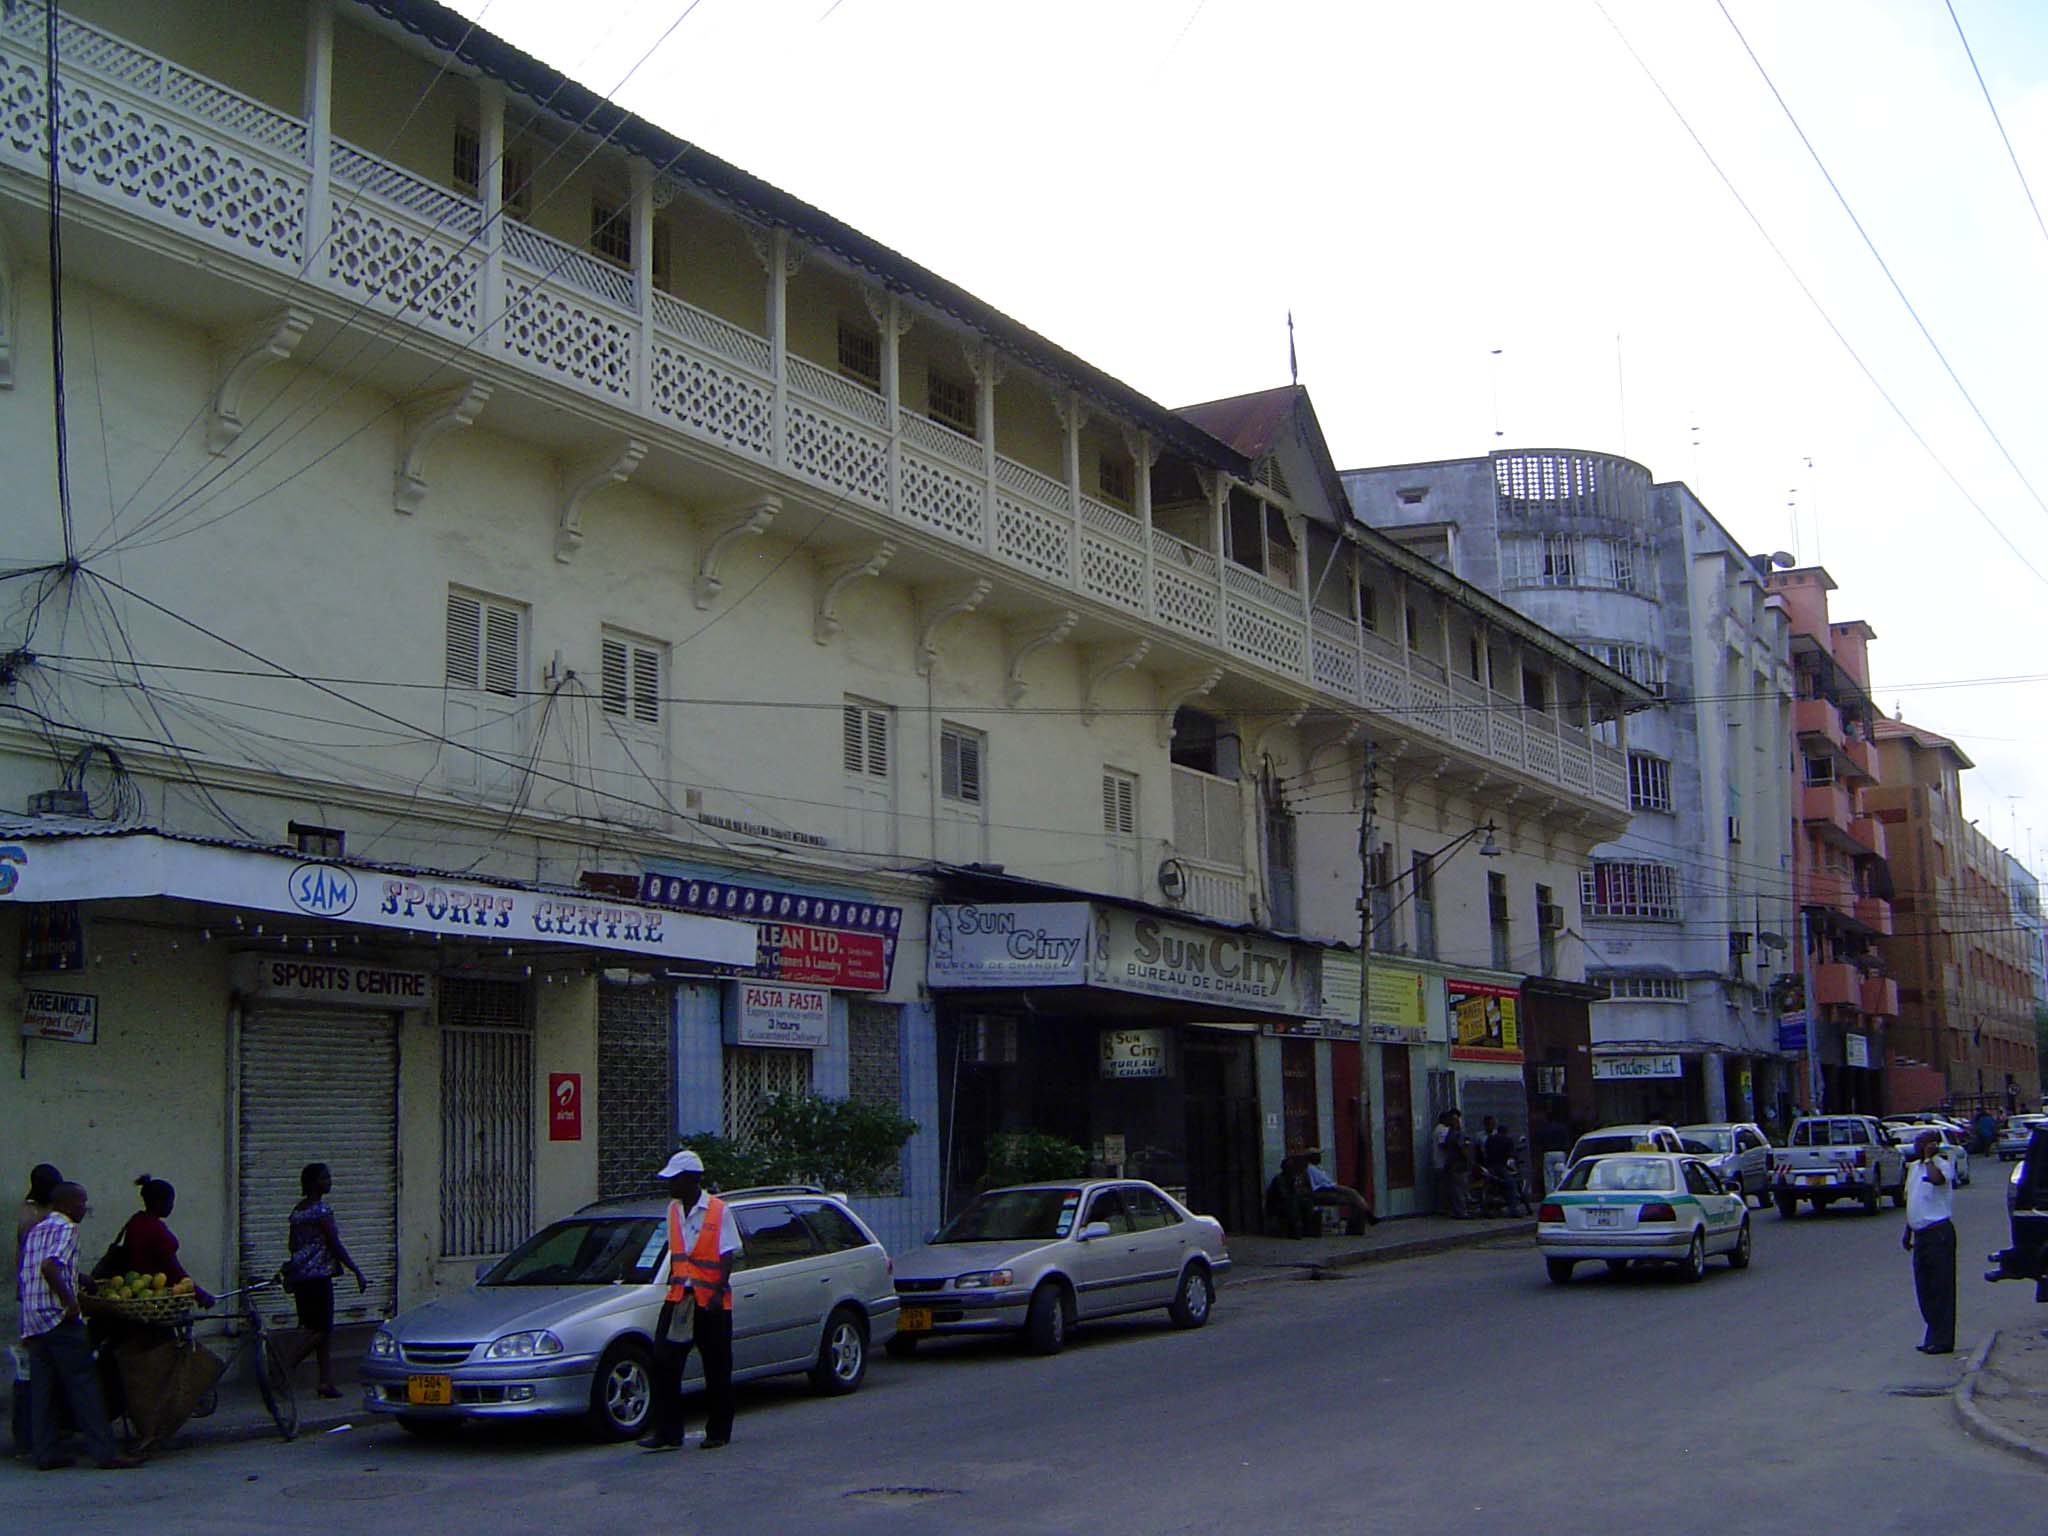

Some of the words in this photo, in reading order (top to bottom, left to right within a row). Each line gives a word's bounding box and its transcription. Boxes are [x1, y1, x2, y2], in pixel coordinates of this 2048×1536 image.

[299, 866, 347, 910] SAM
[381, 880, 513, 928] SPORTS
[532, 900, 663, 943] CENTRE
[957, 903, 1014, 935] SUN
[757, 924, 803, 950] LEAN
[810, 930, 845, 954] LTD.
[1134, 919, 1205, 973] SUN
[272, 963, 349, 991] SPORTS
[356, 969, 425, 996] CENTRE
[1127, 962, 1185, 985] BUREAU
[1191, 976, 1210, 988] DE
[1216, 979, 1268, 997] CHANGE
[747, 990, 782, 1007] FASTA
[789, 992, 823, 1011] FASTA
